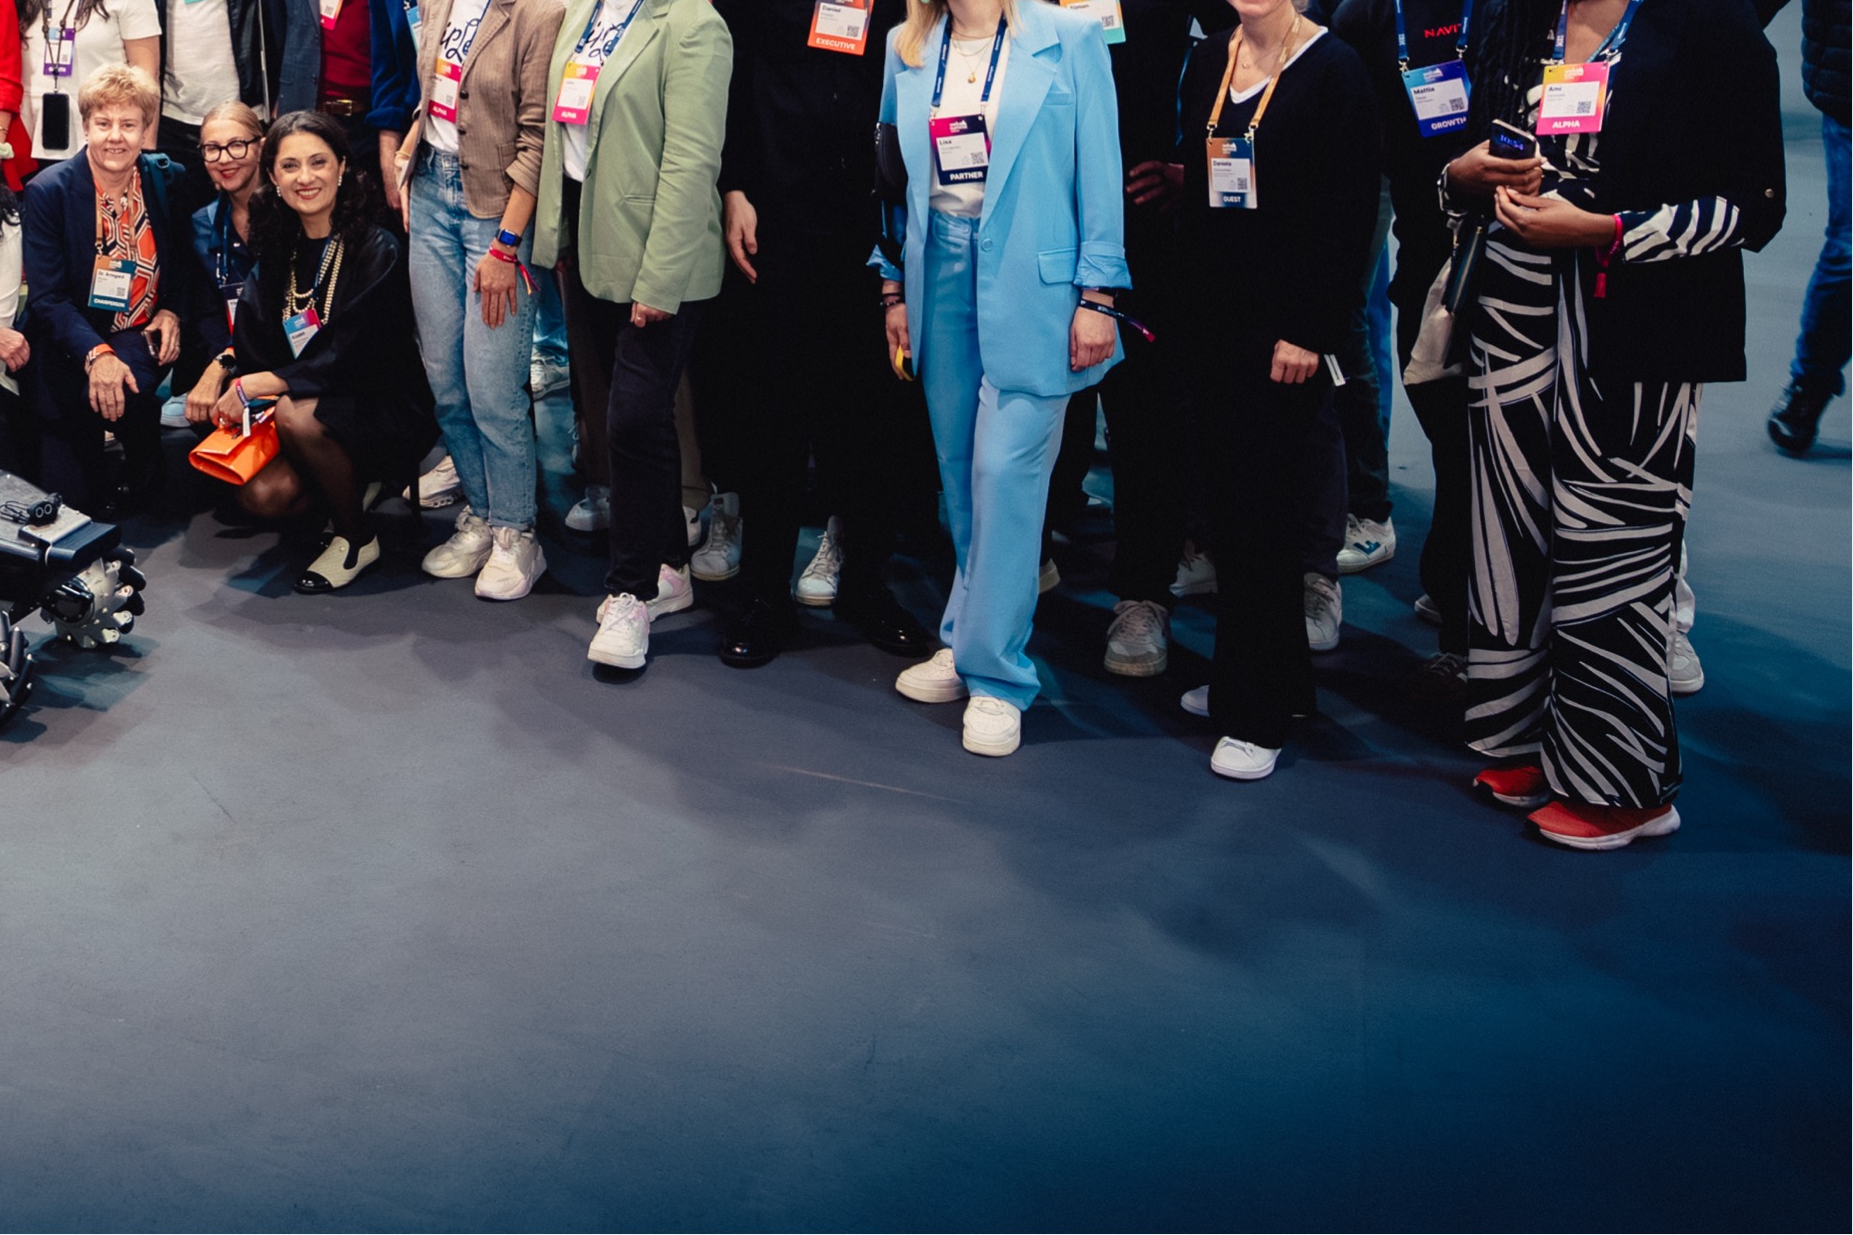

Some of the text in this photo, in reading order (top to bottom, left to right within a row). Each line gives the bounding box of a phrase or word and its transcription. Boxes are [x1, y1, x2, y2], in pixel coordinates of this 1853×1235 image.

[816, 37, 855, 51] EXECUTIVE
[433, 105, 447, 116] ALPHA
[561, 110, 577, 119] ALPHA
[1552, 119, 1581, 129] ALPHA
[949, 170, 984, 181] PARTNER
[1222, 195, 1242, 203] GUEST
[93, 297, 126, 308] CHAIRPERSON
